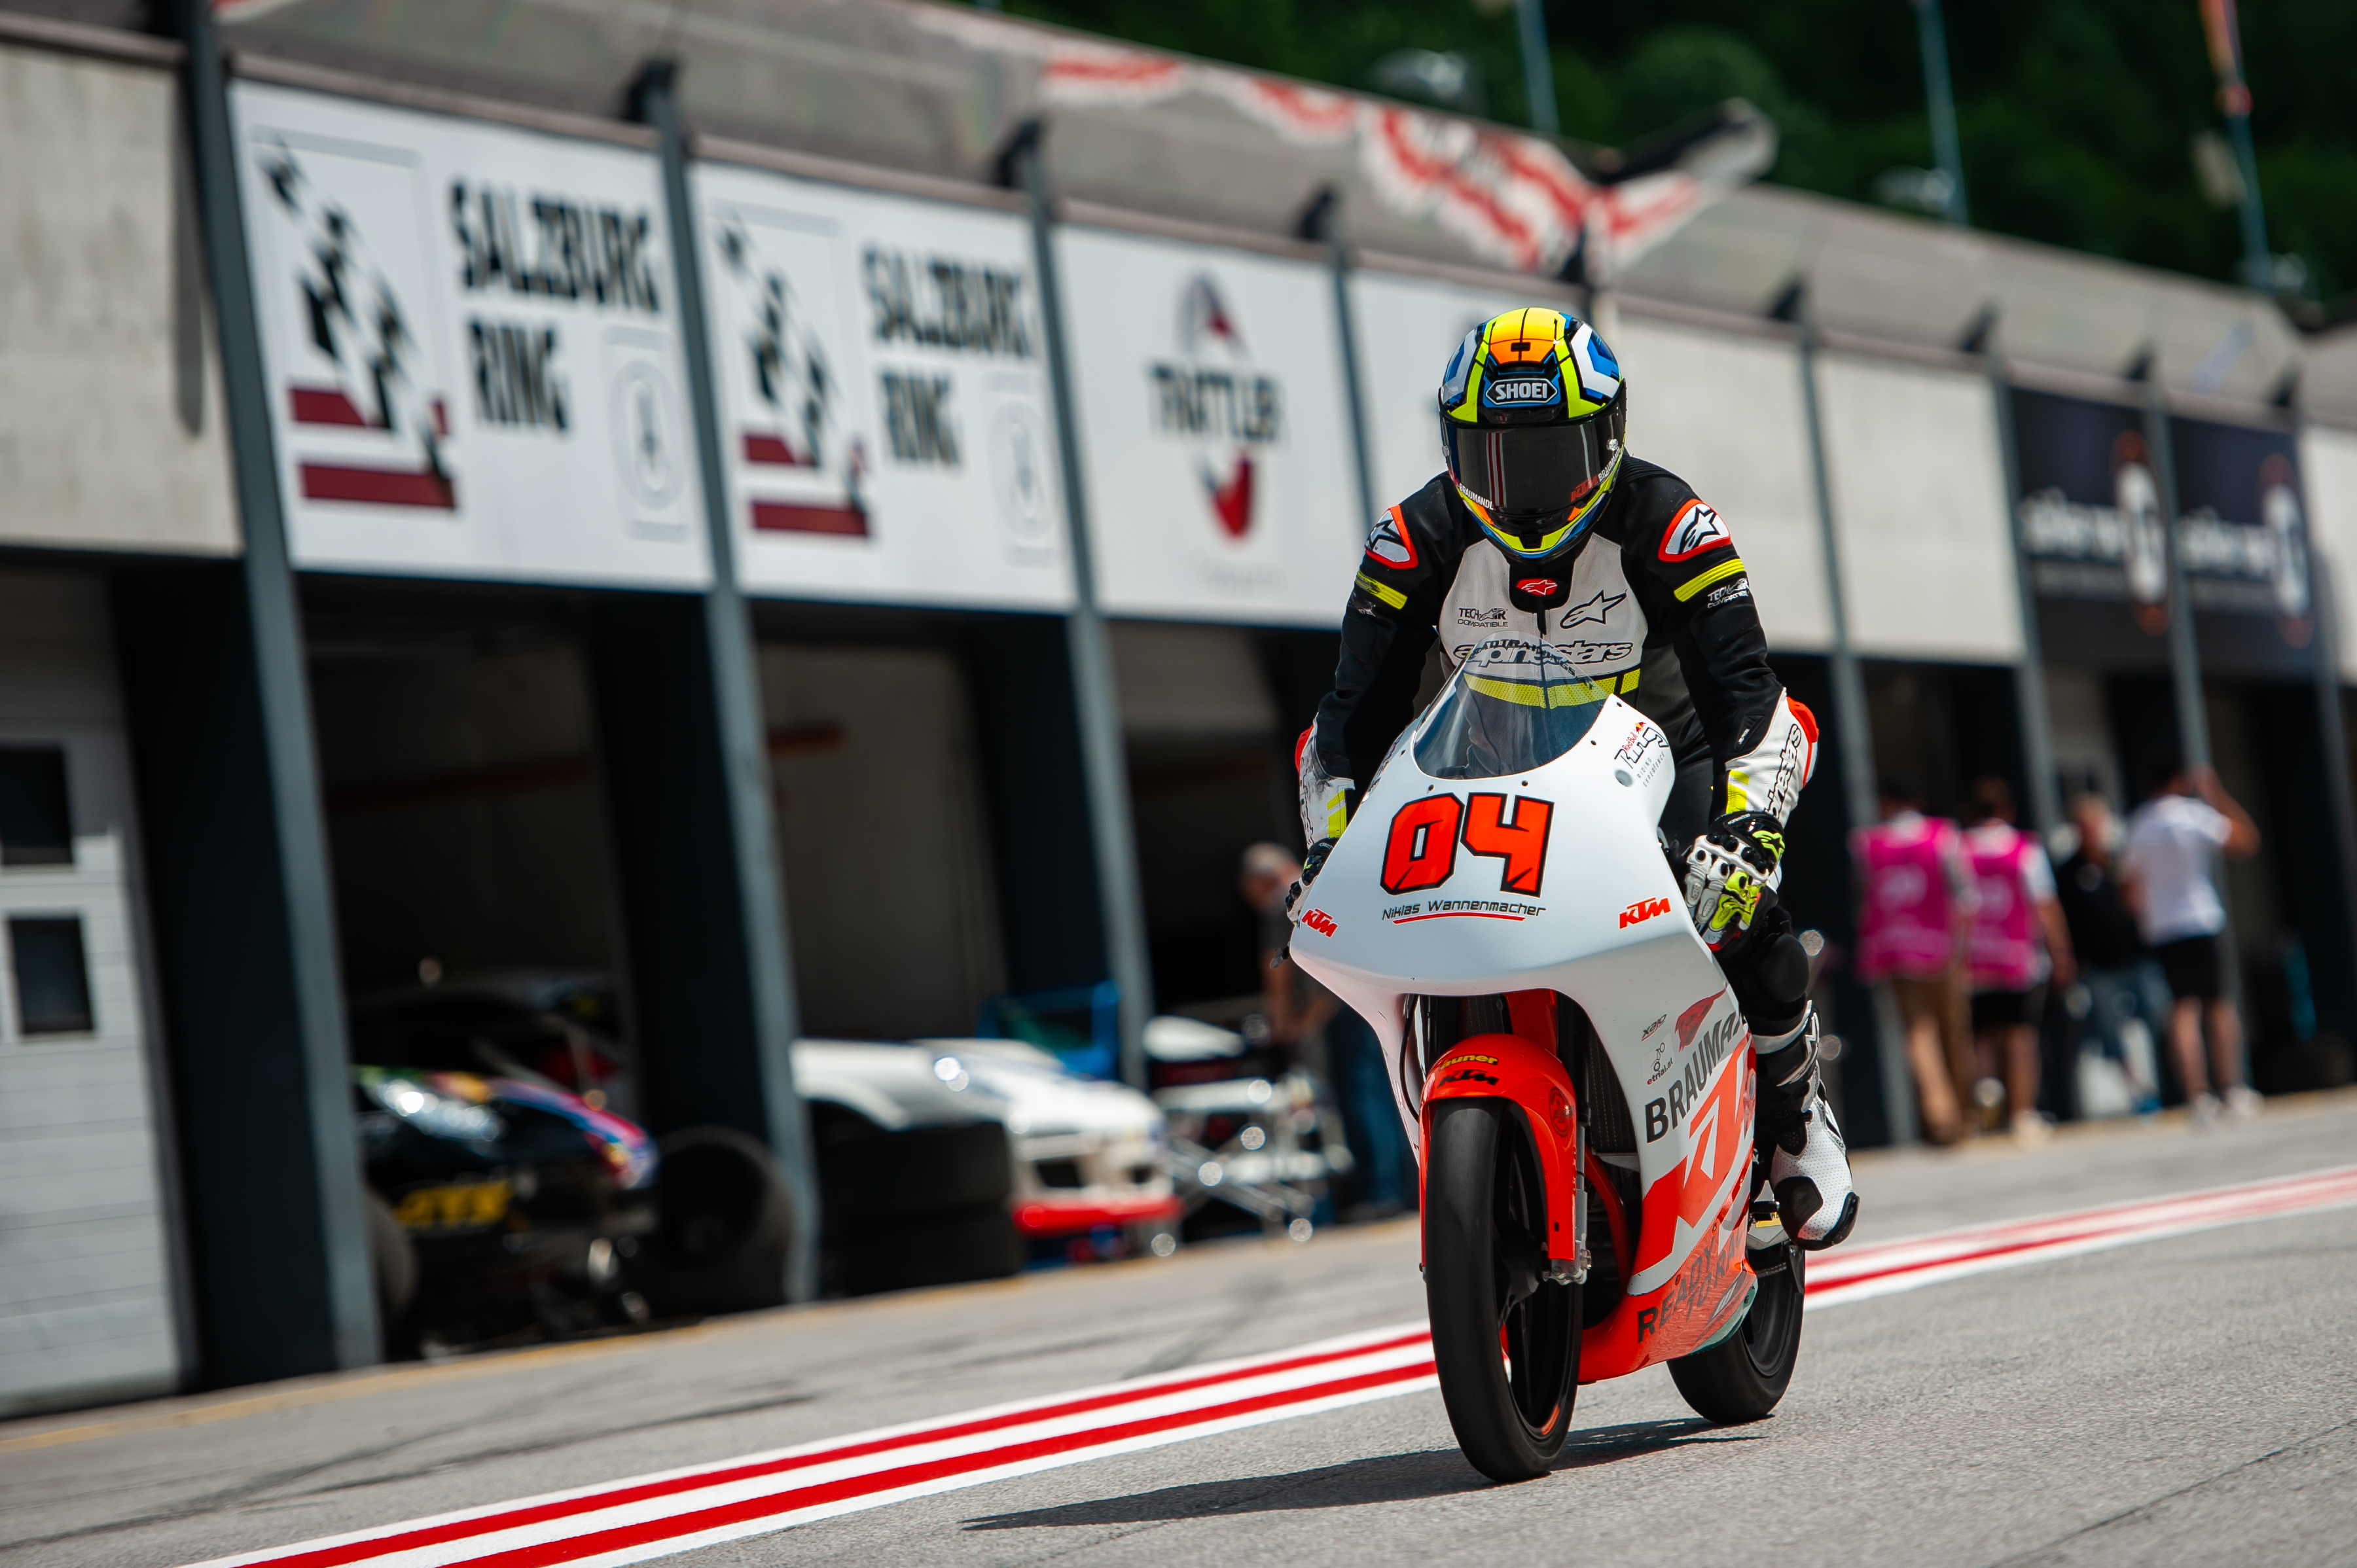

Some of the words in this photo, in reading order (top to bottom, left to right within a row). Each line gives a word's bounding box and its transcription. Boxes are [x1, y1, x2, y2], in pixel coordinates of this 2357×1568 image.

[450, 179, 662, 312] SALZBURG
[469, 321, 568, 429] RING
[1496, 383, 1547, 401] SHOEI
[1459, 483, 1496, 510] BRAUMANDL
[1457, 618, 1509, 628] COMPATIBLE
[1637, 757, 1652, 779] RIDING
[1380, 792, 1555, 897] 04
[1301, 908, 1339, 938] KTM
[1382, 903, 1421, 921] Niklas
[1428, 899, 1547, 917] Wannenmacher
[1619, 897, 1671, 929] KTM
[1637, 1234, 1716, 1343] READY
